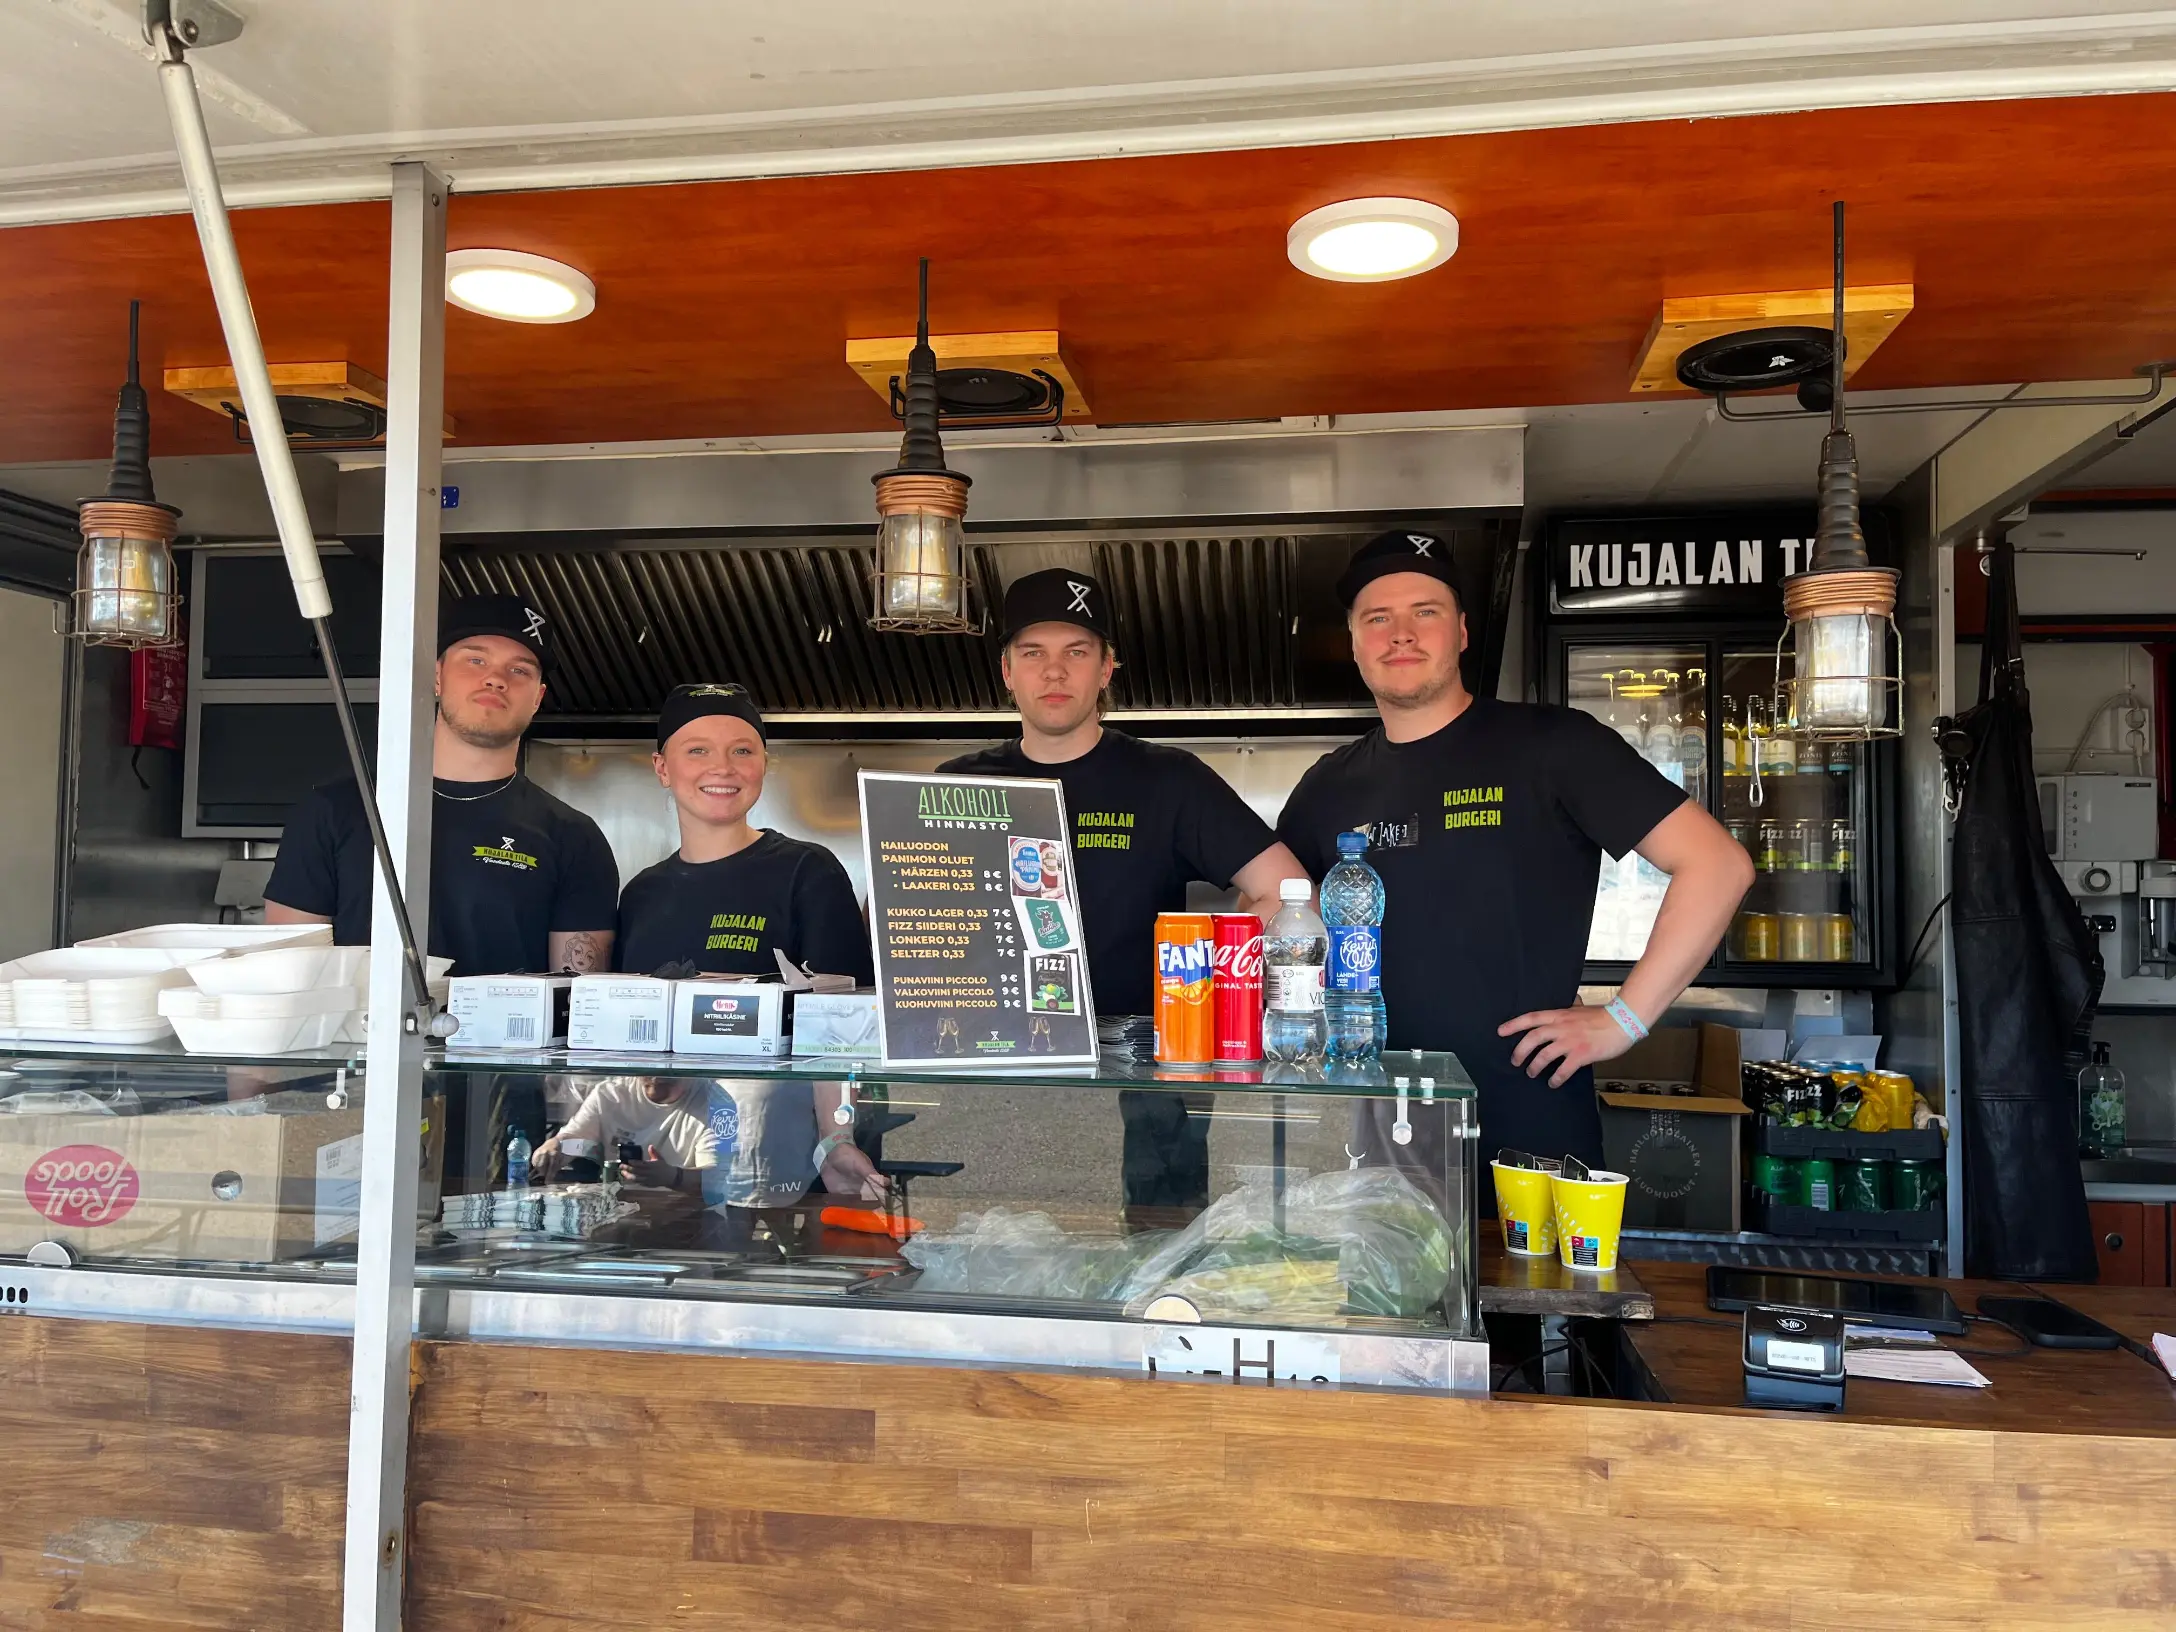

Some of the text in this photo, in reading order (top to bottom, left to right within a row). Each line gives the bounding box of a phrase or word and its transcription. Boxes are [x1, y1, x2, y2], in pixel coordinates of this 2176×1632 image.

[1570, 539, 1763, 588] KUJALAN
[918, 786, 1011, 818] ALKOHOLI
[1443, 786, 1503, 807] KUJALAN
[924, 819, 1009, 831] HINNASTO
[1077, 812, 1135, 828] KUJALAN
[1444, 809, 1501, 830] BURGERI
[1077, 833, 1131, 850] BURGERI
[1759, 829, 1785, 842] FIZZ
[880, 840, 949, 852] HAILUODON
[881, 854, 974, 865] PANIMON OLUET
[900, 866, 1002, 879] MÄRZEN 0,33 8 €
[902, 881, 1004, 893] LAAKERI 0,33 8 €
[886, 908, 1011, 918] KUKKO LAGER 0,33 7 €
[710, 913, 767, 932] KUJALAN
[888, 921, 1013, 931] FIZZ SIIDERI 0,33 7 €
[705, 934, 759, 953] BURGERI
[889, 935, 1014, 945] LONKERO 0,33 7 €
[890, 949, 1016, 959] SELTZER 0,33 7 €
[1158, 939, 1214, 972] FANT
[1036, 957, 1066, 973] FIZZ
[893, 974, 1018, 985] PUNAVIINI PICCOLO 9 €
[894, 987, 1019, 996] VALKOVIINI PICCOLO 9 €
[895, 1000, 1021, 1009] KUOHUVIINI PICCOLO 9 €
[761, 1045, 772, 1053] XL
[34, 1158, 132, 1190] foods
[44, 1183, 129, 1222] Roll
